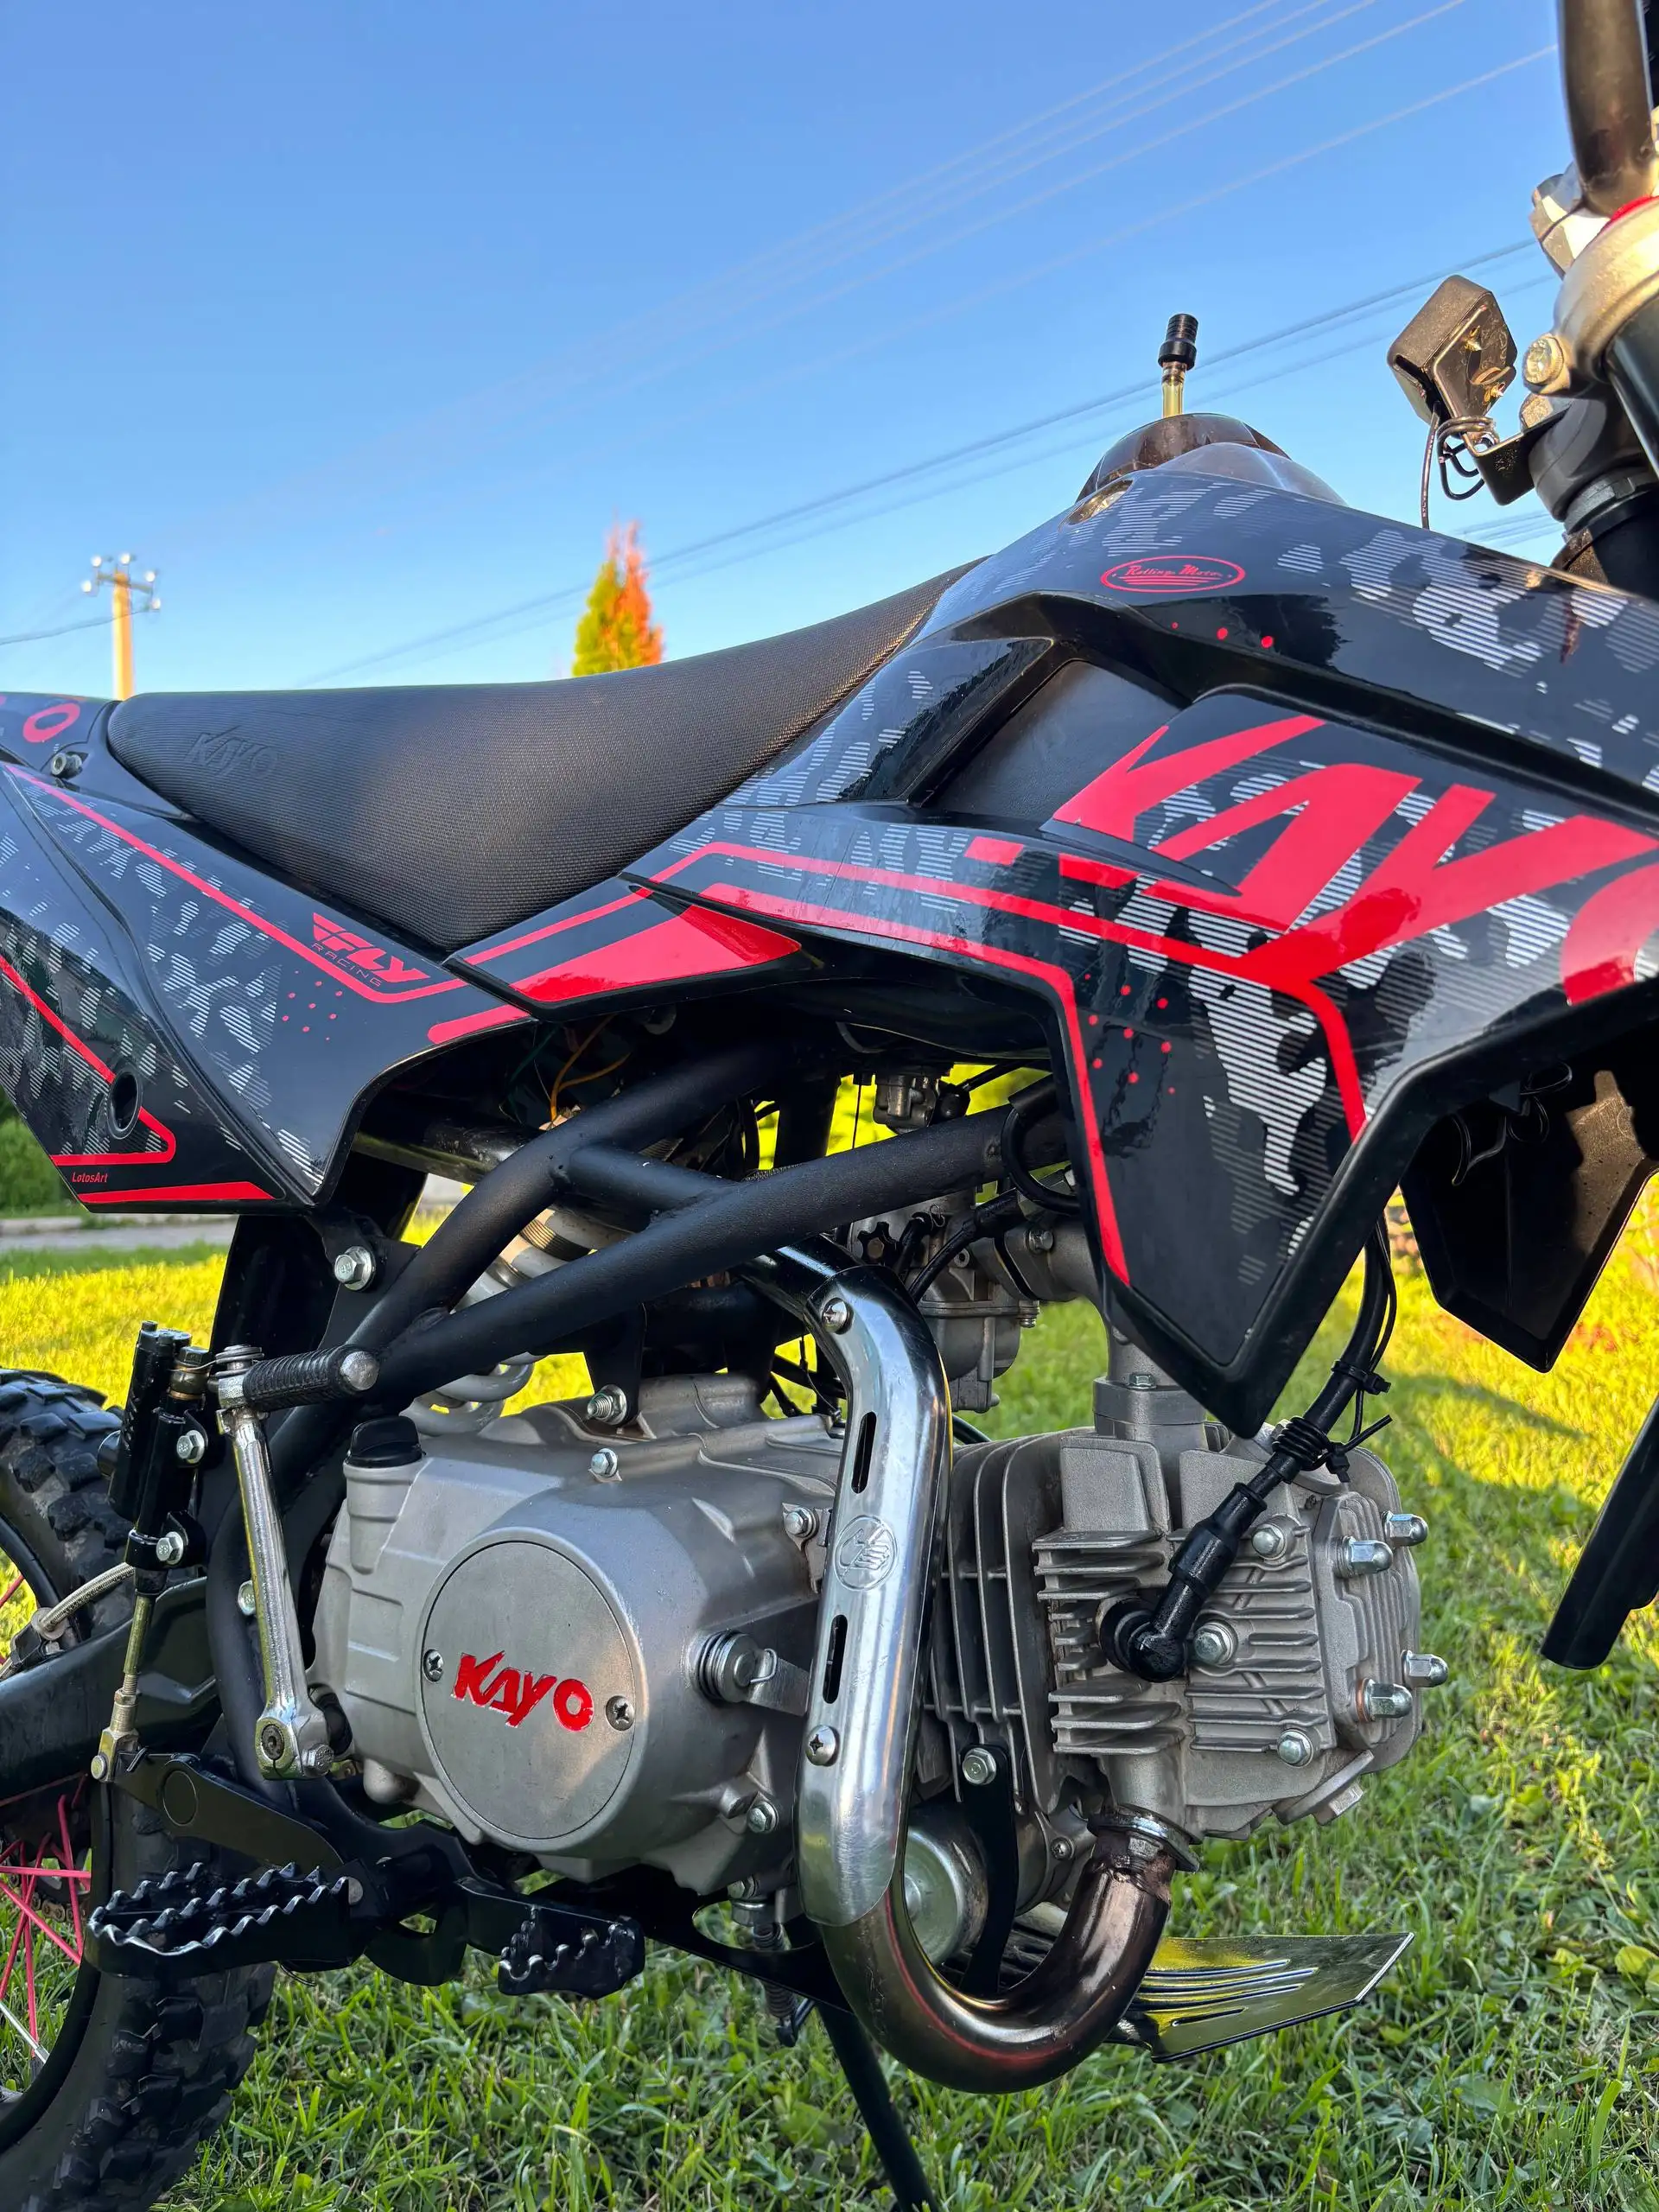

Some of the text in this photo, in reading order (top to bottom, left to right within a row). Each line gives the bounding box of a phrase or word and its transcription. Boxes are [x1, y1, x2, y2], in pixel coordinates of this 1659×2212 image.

[311, 942, 383, 988] RACING
[313, 912, 431, 983] FLY
[72, 1171, 108, 1183] LotosArt
[450, 1649, 595, 1732] KAYO
